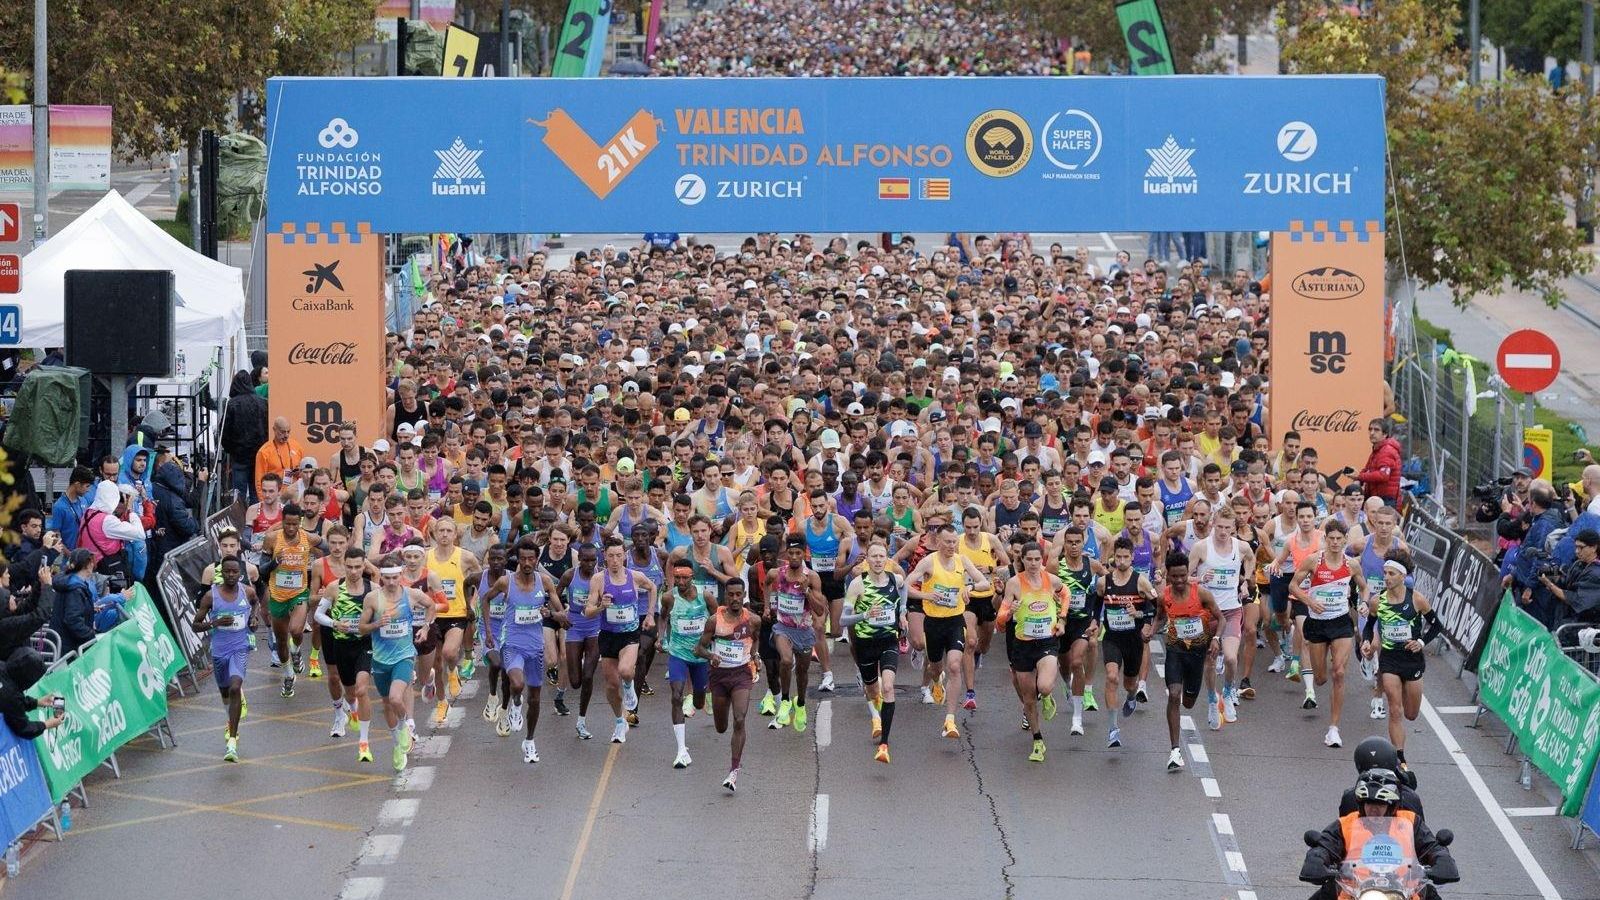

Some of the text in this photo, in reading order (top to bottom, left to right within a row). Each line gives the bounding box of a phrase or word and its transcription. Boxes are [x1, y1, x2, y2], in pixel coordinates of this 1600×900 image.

[561, 11, 594, 60] 2
[674, 108, 805, 135] VALENCIA
[1053, 130, 1092, 139] SUPER
[1052, 140, 1091, 150] HALFS
[297, 151, 381, 163] FUNDACIÓN
[597, 127, 646, 184] 21K
[675, 143, 952, 167] TRINIDAD ALFONSO
[297, 165, 382, 180] TRINIDAD
[297, 181, 382, 195] ALFONSO
[432, 181, 486, 195] luanvi
[716, 180, 803, 198] ZURICH
[1143, 179, 1198, 194] luanvi
[1243, 172, 1352, 194] ZURICH
[1298, 279, 1359, 292] ASTURIANA
[292, 298, 354, 311] CaixaBank
[288, 342, 358, 365] Coca-Cola
[1292, 409, 1361, 433] Coca-Cola
